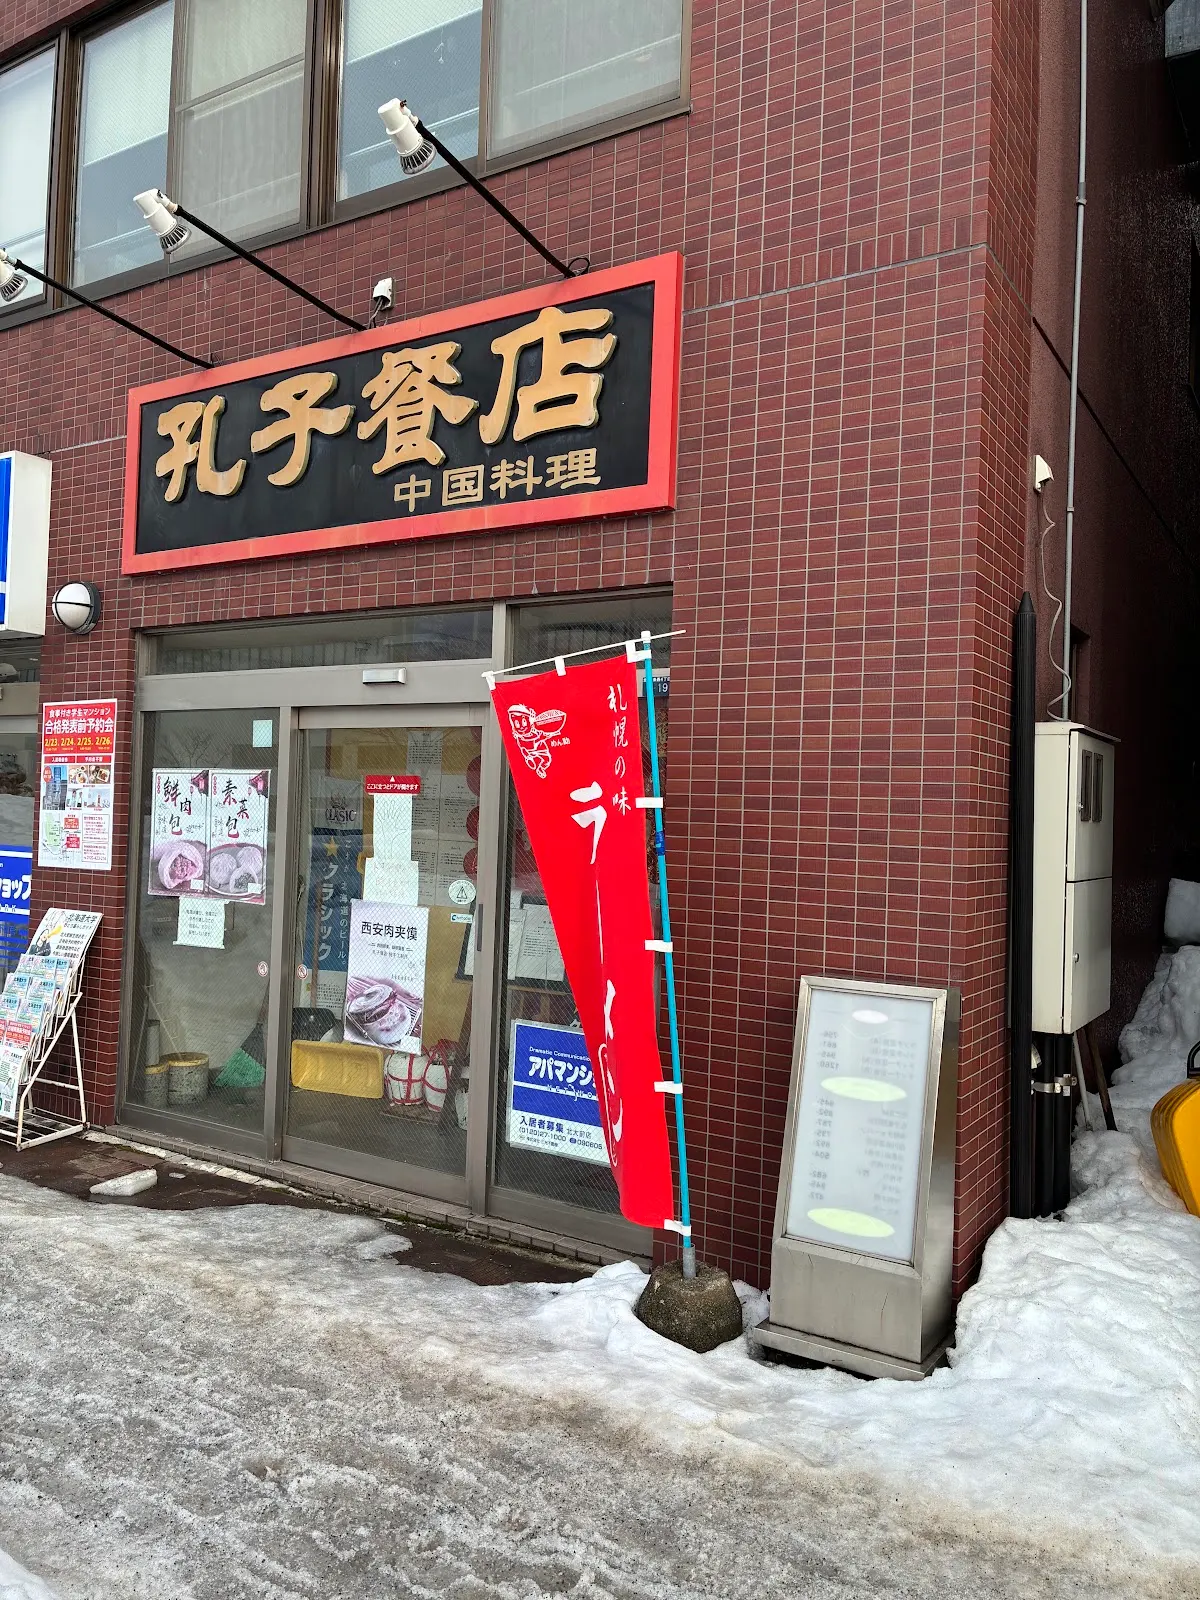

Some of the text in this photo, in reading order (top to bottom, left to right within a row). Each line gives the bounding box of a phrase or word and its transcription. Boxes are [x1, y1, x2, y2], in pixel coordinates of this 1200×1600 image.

[155, 306, 617, 504] 孔子餐店
[393, 447, 602, 513] 中国料理
[49, 708, 111, 719] 食事付き学生マンション
[45, 717, 114, 735] 合格発表前予約会
[550, 737, 571, 748] めん助
[606, 683, 632, 816] 札幌の味
[366, 782, 420, 792] ここに立つとドアが開きます
[68, 913, 98, 923] 北海道大学
[318, 861, 339, 962] クラシック
[361, 921, 418, 941] 西安肉夹馍
[529, 1046, 591, 1062] Dramatic Communicatio
[528, 1055, 597, 1089] アパマンシ
[518, 1126, 567, 1142] (0120)27-1000
[519, 1115, 592, 1140] 入居者募集 北大前店
